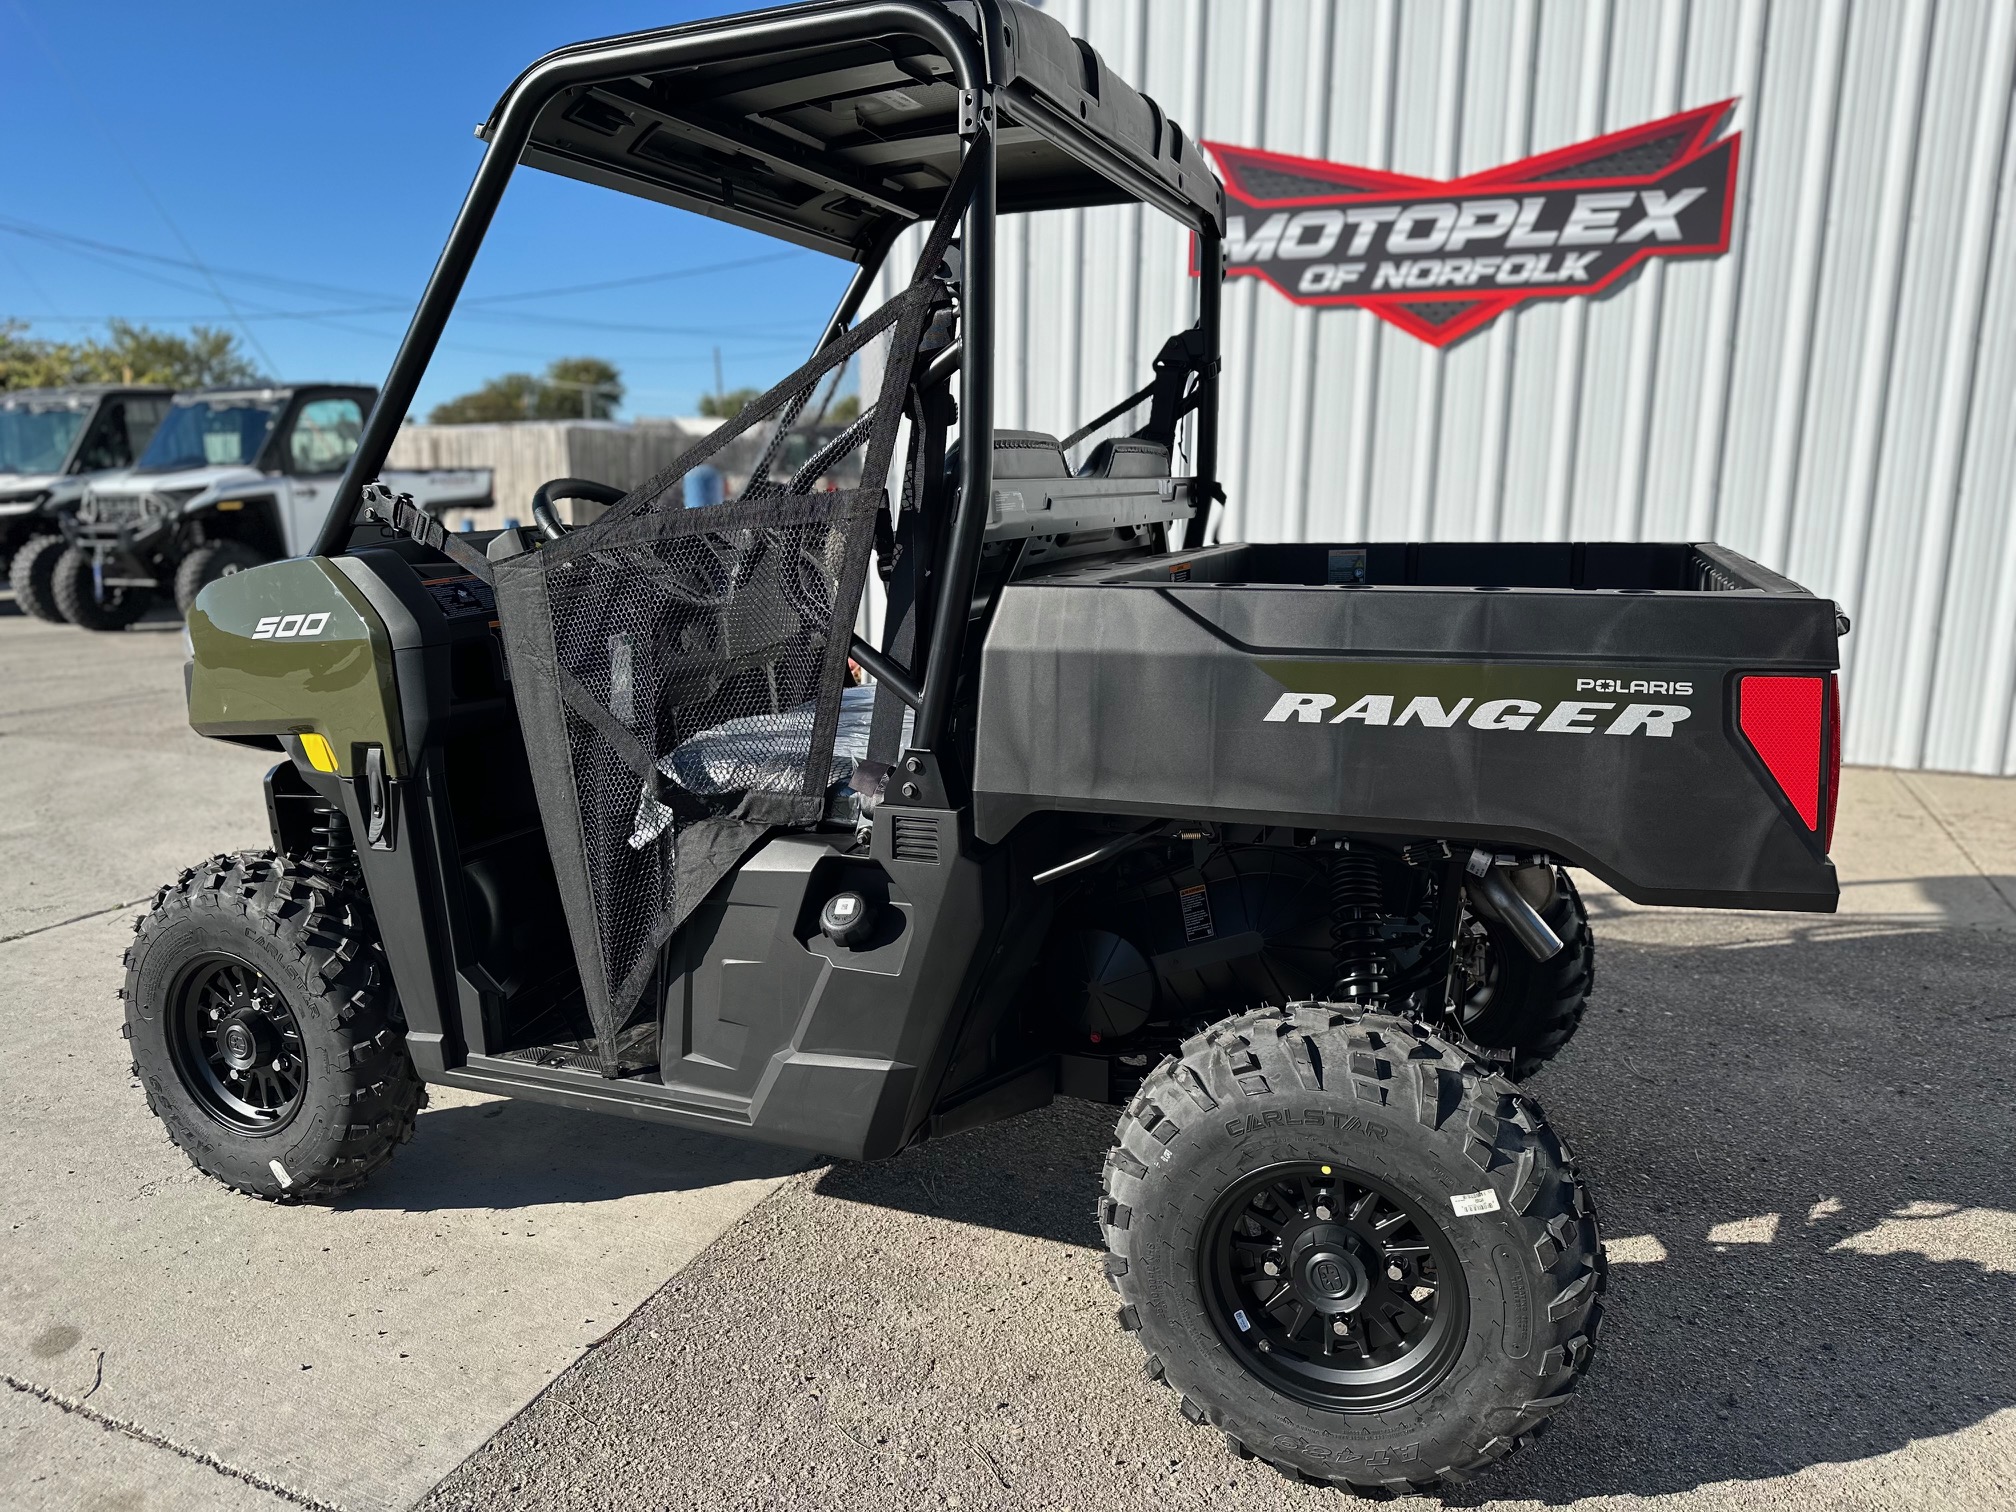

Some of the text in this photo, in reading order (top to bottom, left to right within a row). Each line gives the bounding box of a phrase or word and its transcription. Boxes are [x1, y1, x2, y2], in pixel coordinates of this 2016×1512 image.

[1222, 187, 1707, 262] MOTOPLEX
[1298, 251, 1602, 293] OF NORFOLK
[251, 612, 331, 640] 500
[1576, 678, 1694, 696] POLARIS
[1262, 692, 1692, 738] RANGER
[244, 927, 320, 1019] CARLSTAR
[1224, 1107, 1389, 1143] CARLSTAR
[1273, 1433, 1420, 1467] AT489
